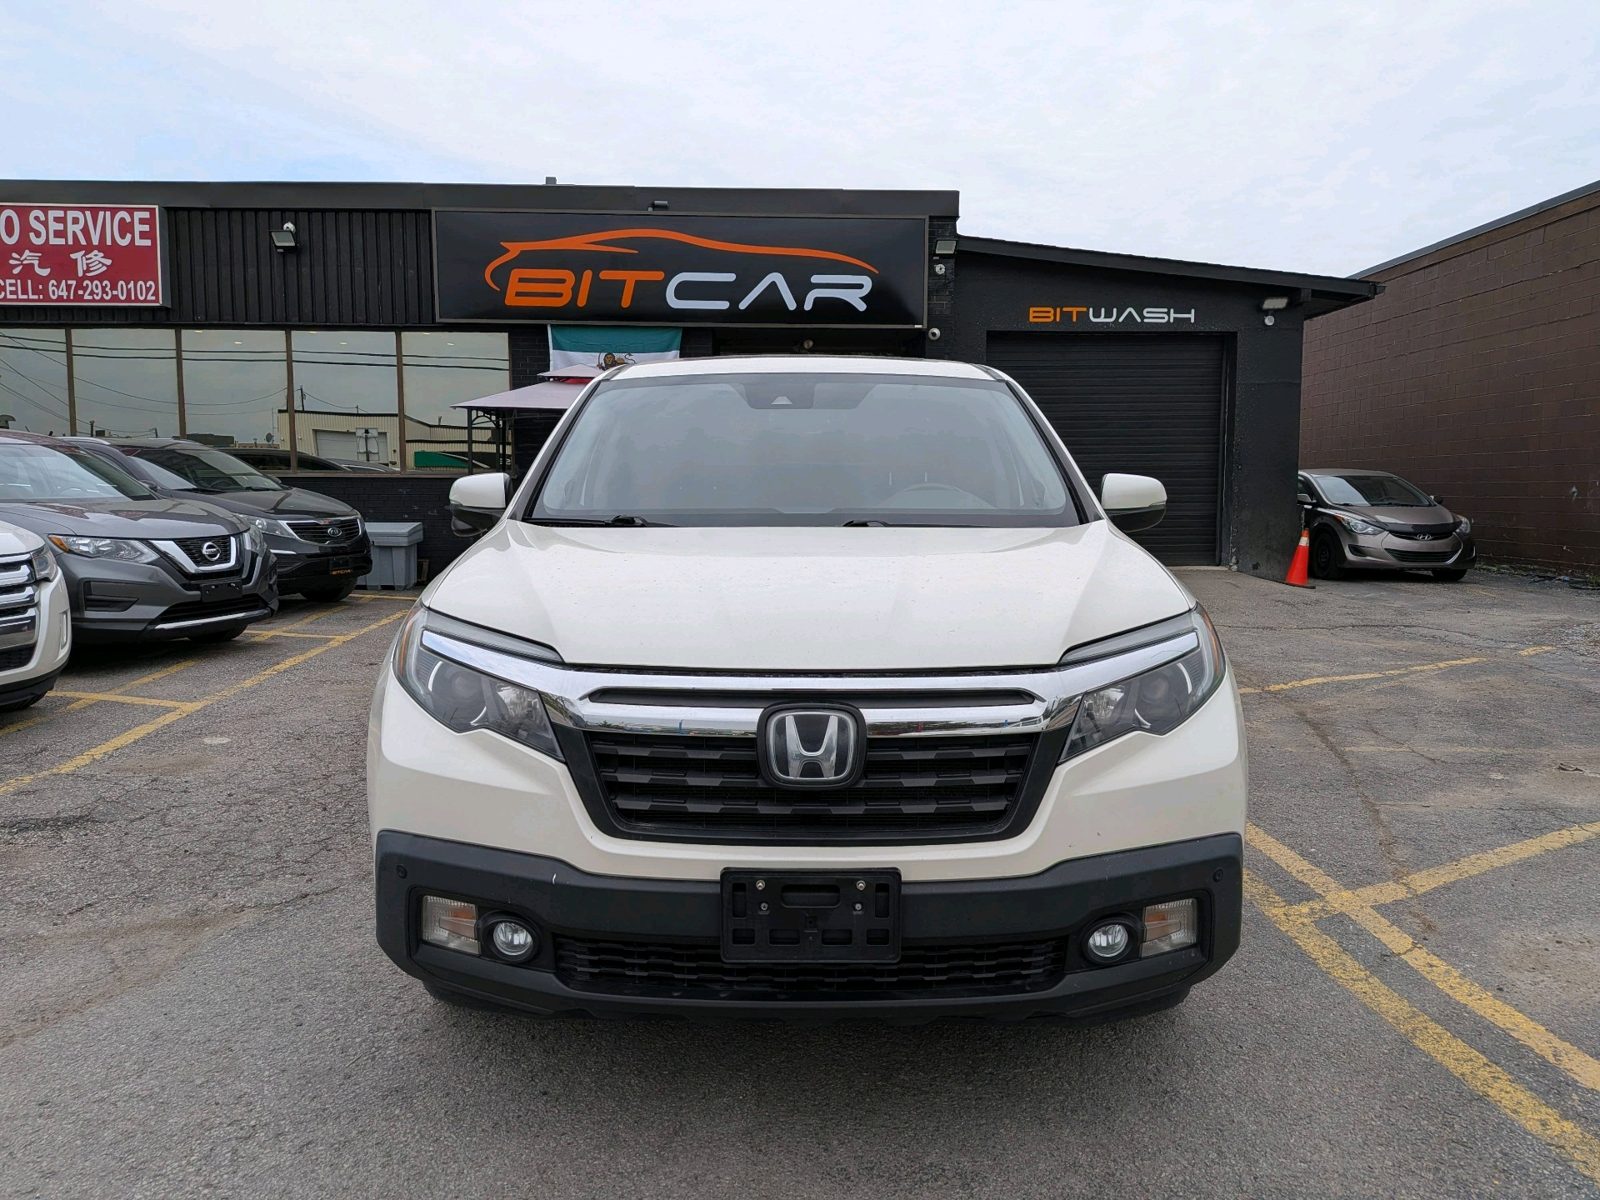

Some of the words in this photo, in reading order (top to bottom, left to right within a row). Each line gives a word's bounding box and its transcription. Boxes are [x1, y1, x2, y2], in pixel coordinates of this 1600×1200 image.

[29, 209, 152, 246] SERVICE
[48, 279, 156, 300] 647-293-0102
[505, 268, 873, 312] BITCAR
[1028, 306, 1195, 324] BITWASH
